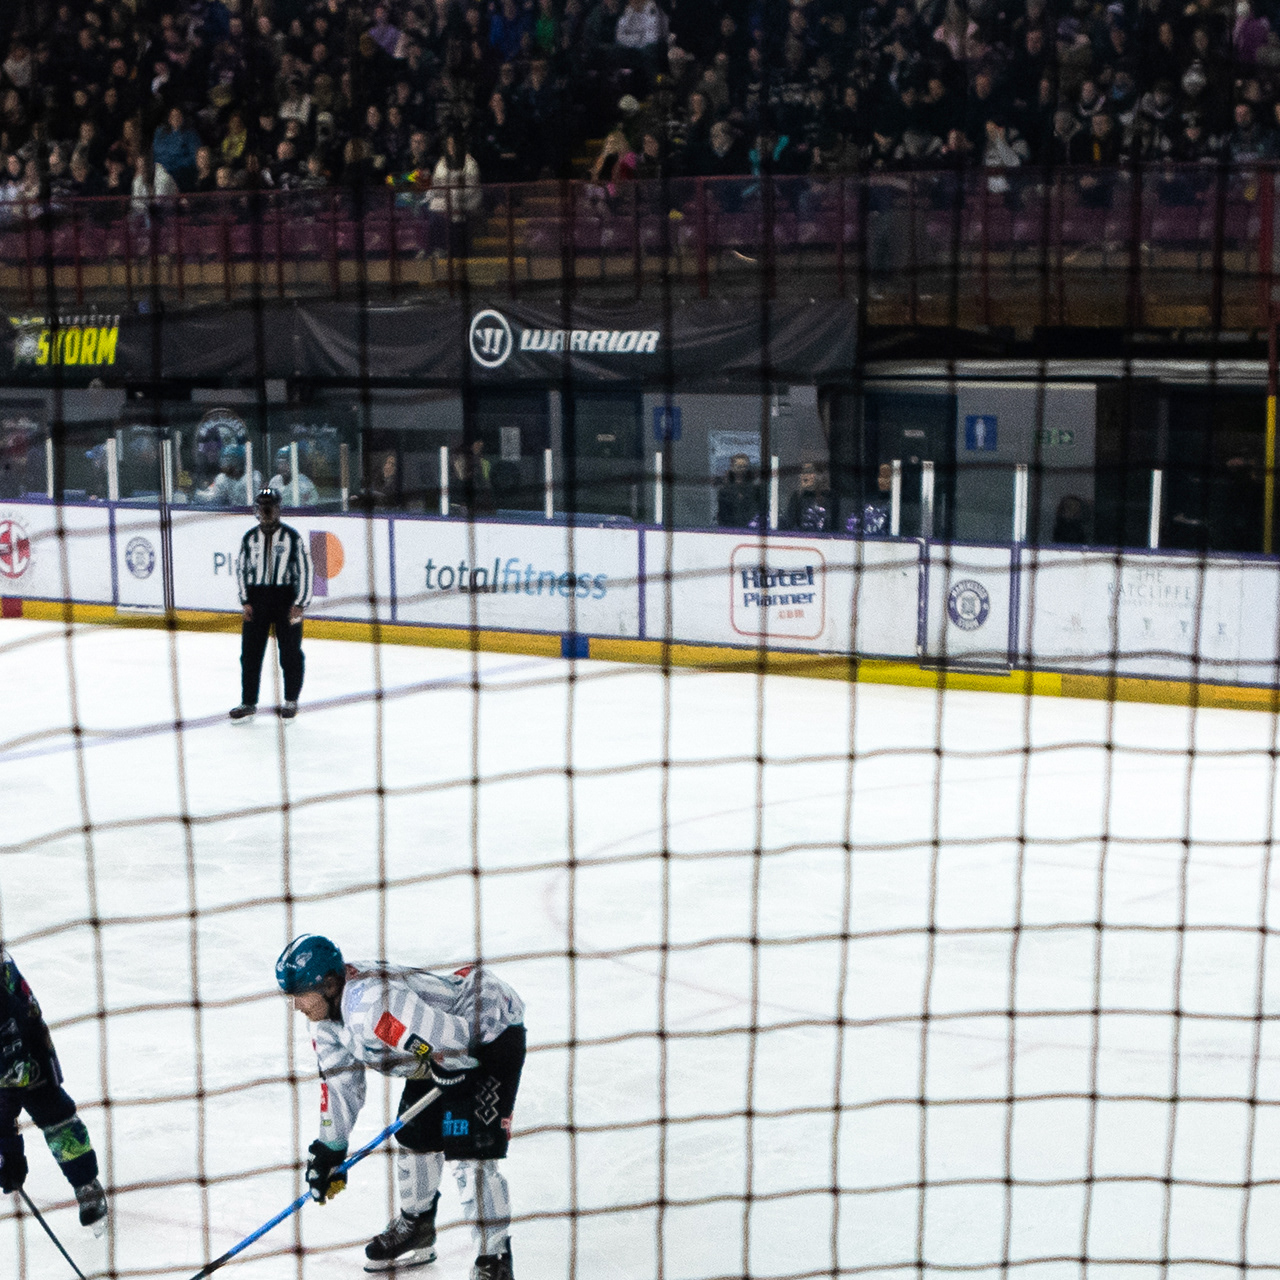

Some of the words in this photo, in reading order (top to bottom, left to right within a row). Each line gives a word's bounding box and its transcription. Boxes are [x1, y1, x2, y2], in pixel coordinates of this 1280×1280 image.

[520, 329, 661, 354] WARRIOR
[424, 556, 609, 600] totalfitness
[741, 565, 815, 589] Hotel
[743, 592, 817, 608] Planner
